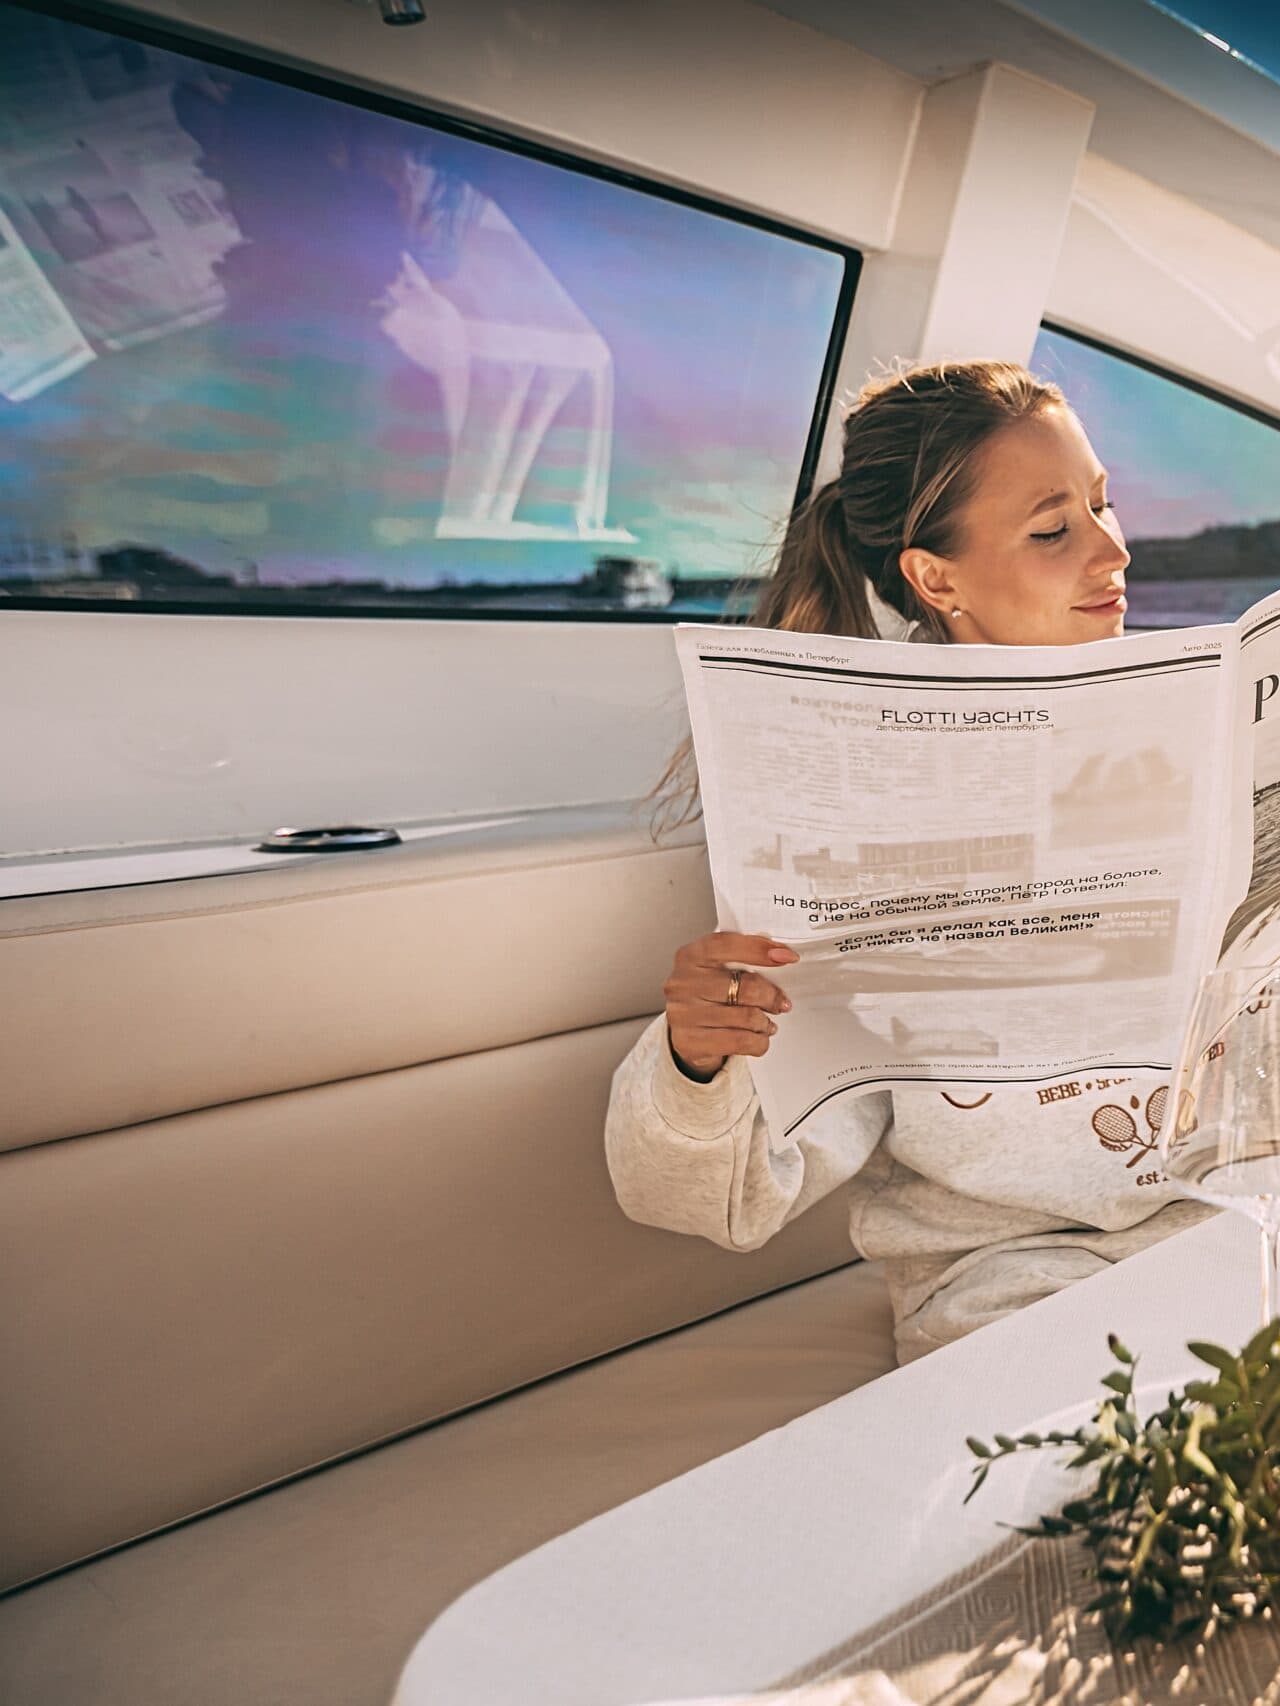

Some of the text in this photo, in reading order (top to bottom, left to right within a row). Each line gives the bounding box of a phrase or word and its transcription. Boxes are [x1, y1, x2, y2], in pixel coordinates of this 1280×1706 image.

[1204, 642, 1222, 650] 2025
[881, 709, 956, 724] FLOTTI
[773, 868, 1162, 913] На вопрос, почему мы строим город на болоте,
[808, 914, 819, 923] а
[824, 912, 845, 922] не
[850, 911, 870, 920] на
[875, 900, 947, 917] обычной
[1062, 880, 1128, 895] ответил:
[839, 922, 1094, 953] бы никто не назвал Великим!»
[889, 928, 911, 938] бы
[931, 921, 983, 933] делал
[988, 918, 1016, 928] как
[1022, 916, 1055, 926] все,
[1060, 911, 1100, 922] меня
[1036, 1080, 1082, 1105] BEBE
[1136, 1170, 1159, 1186] est
